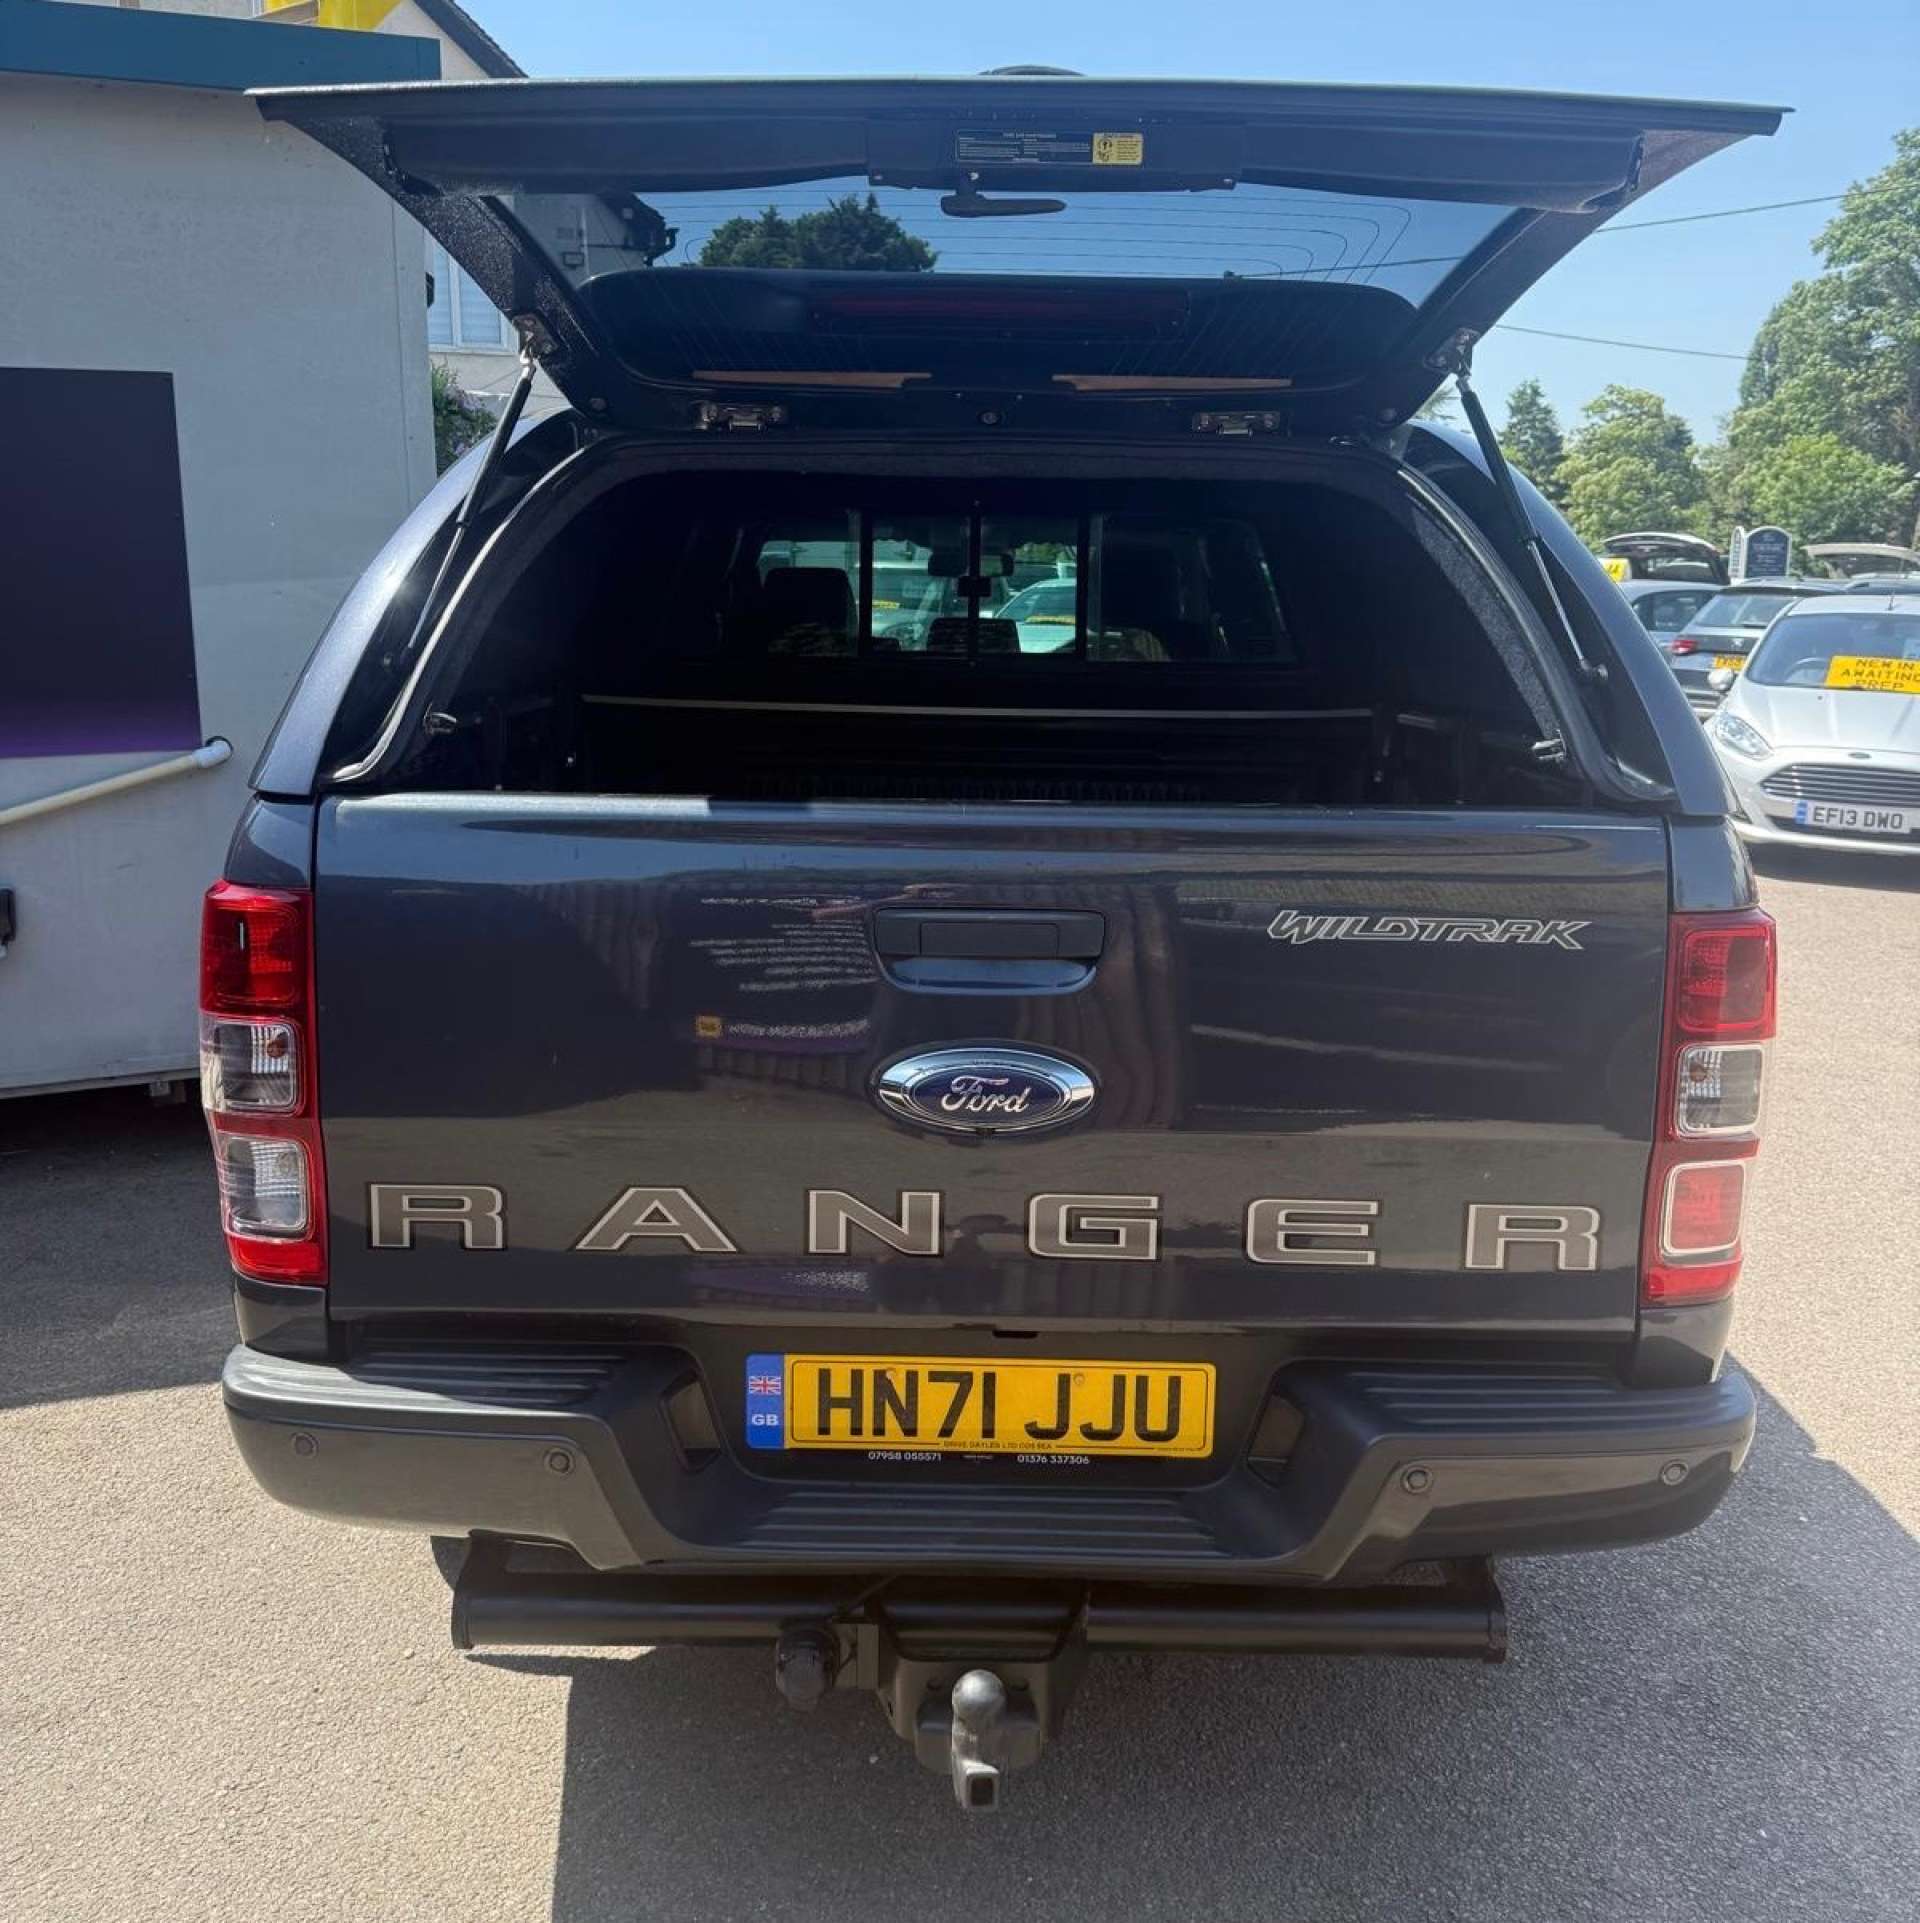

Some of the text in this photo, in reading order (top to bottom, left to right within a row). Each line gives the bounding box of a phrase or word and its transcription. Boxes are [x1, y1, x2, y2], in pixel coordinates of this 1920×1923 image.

[1856, 660, 1915, 670] NEW IN
[1813, 806, 1903, 829] EF13 DWO
[1267, 910, 1592, 949] WILDTRAK
[941, 1074, 1032, 1113] Ford
[370, 1183, 1600, 1270] RANGER
[751, 1413, 780, 1426] GB
[817, 1367, 1182, 1442] HN71 JJU
